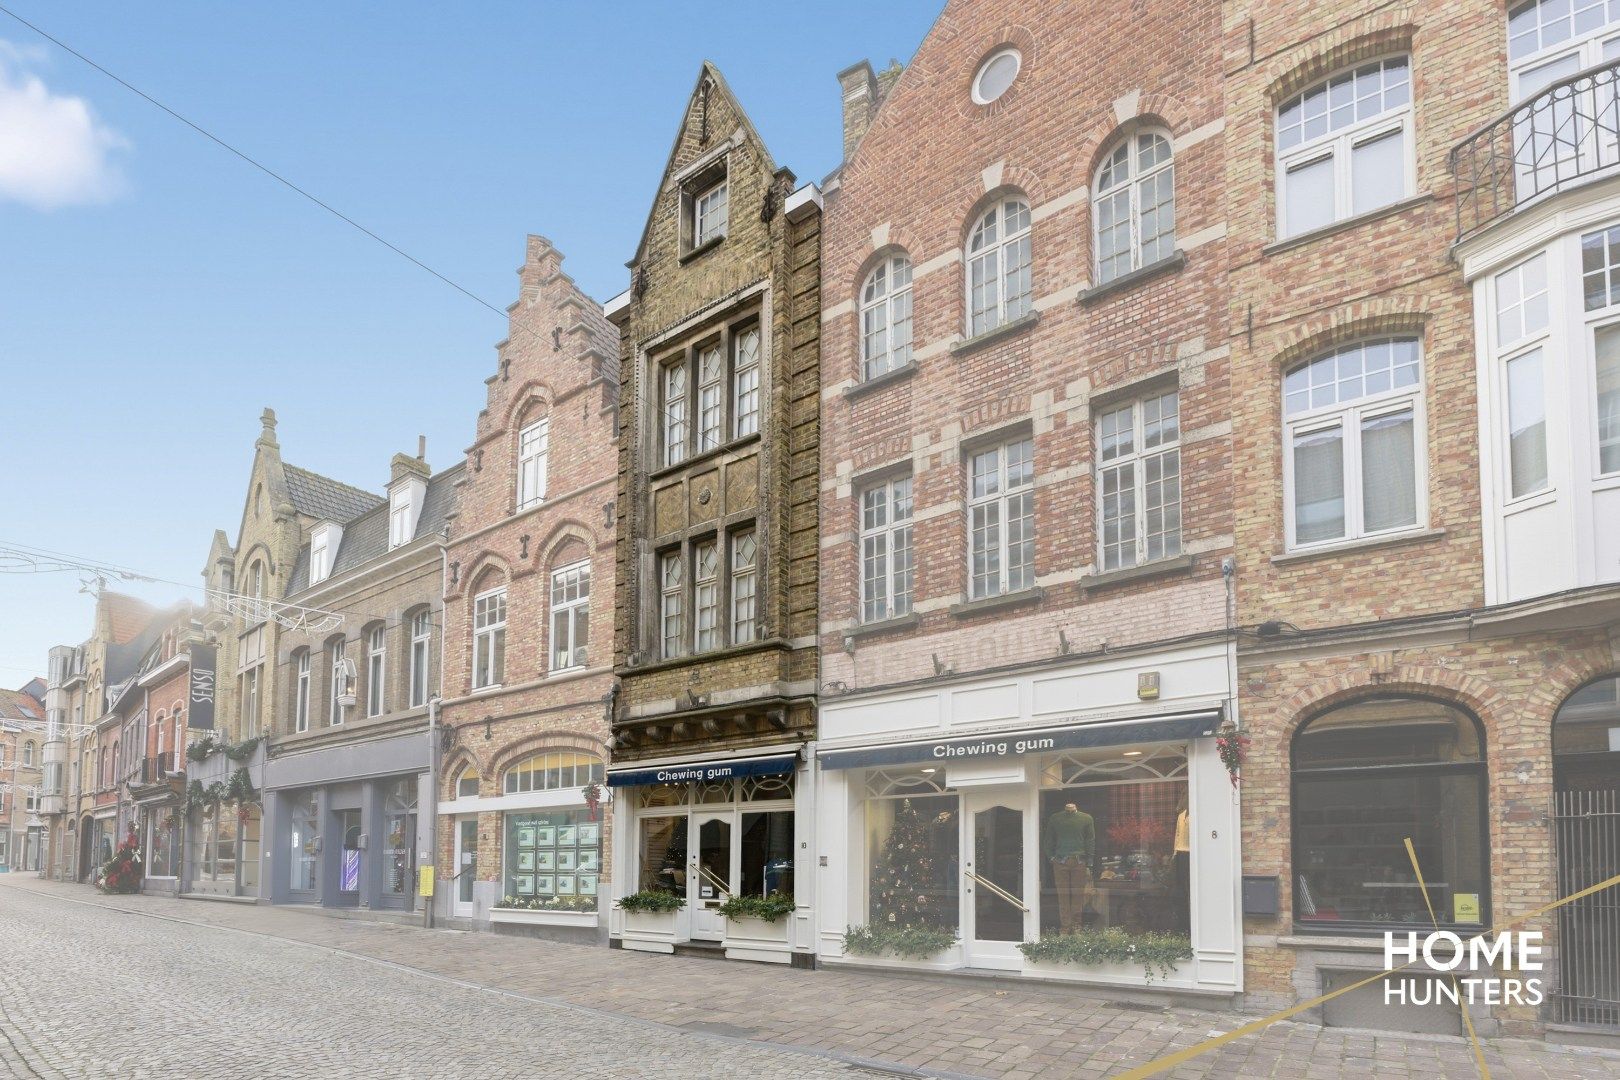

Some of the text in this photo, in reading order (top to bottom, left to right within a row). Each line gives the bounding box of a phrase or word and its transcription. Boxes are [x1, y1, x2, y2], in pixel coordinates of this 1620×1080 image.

[192, 668, 214, 703] SENSO
[933, 738, 1054, 757] Chewing gum
[657, 767, 732, 781] Chewing gum
[1211, 830, 1218, 839] 8
